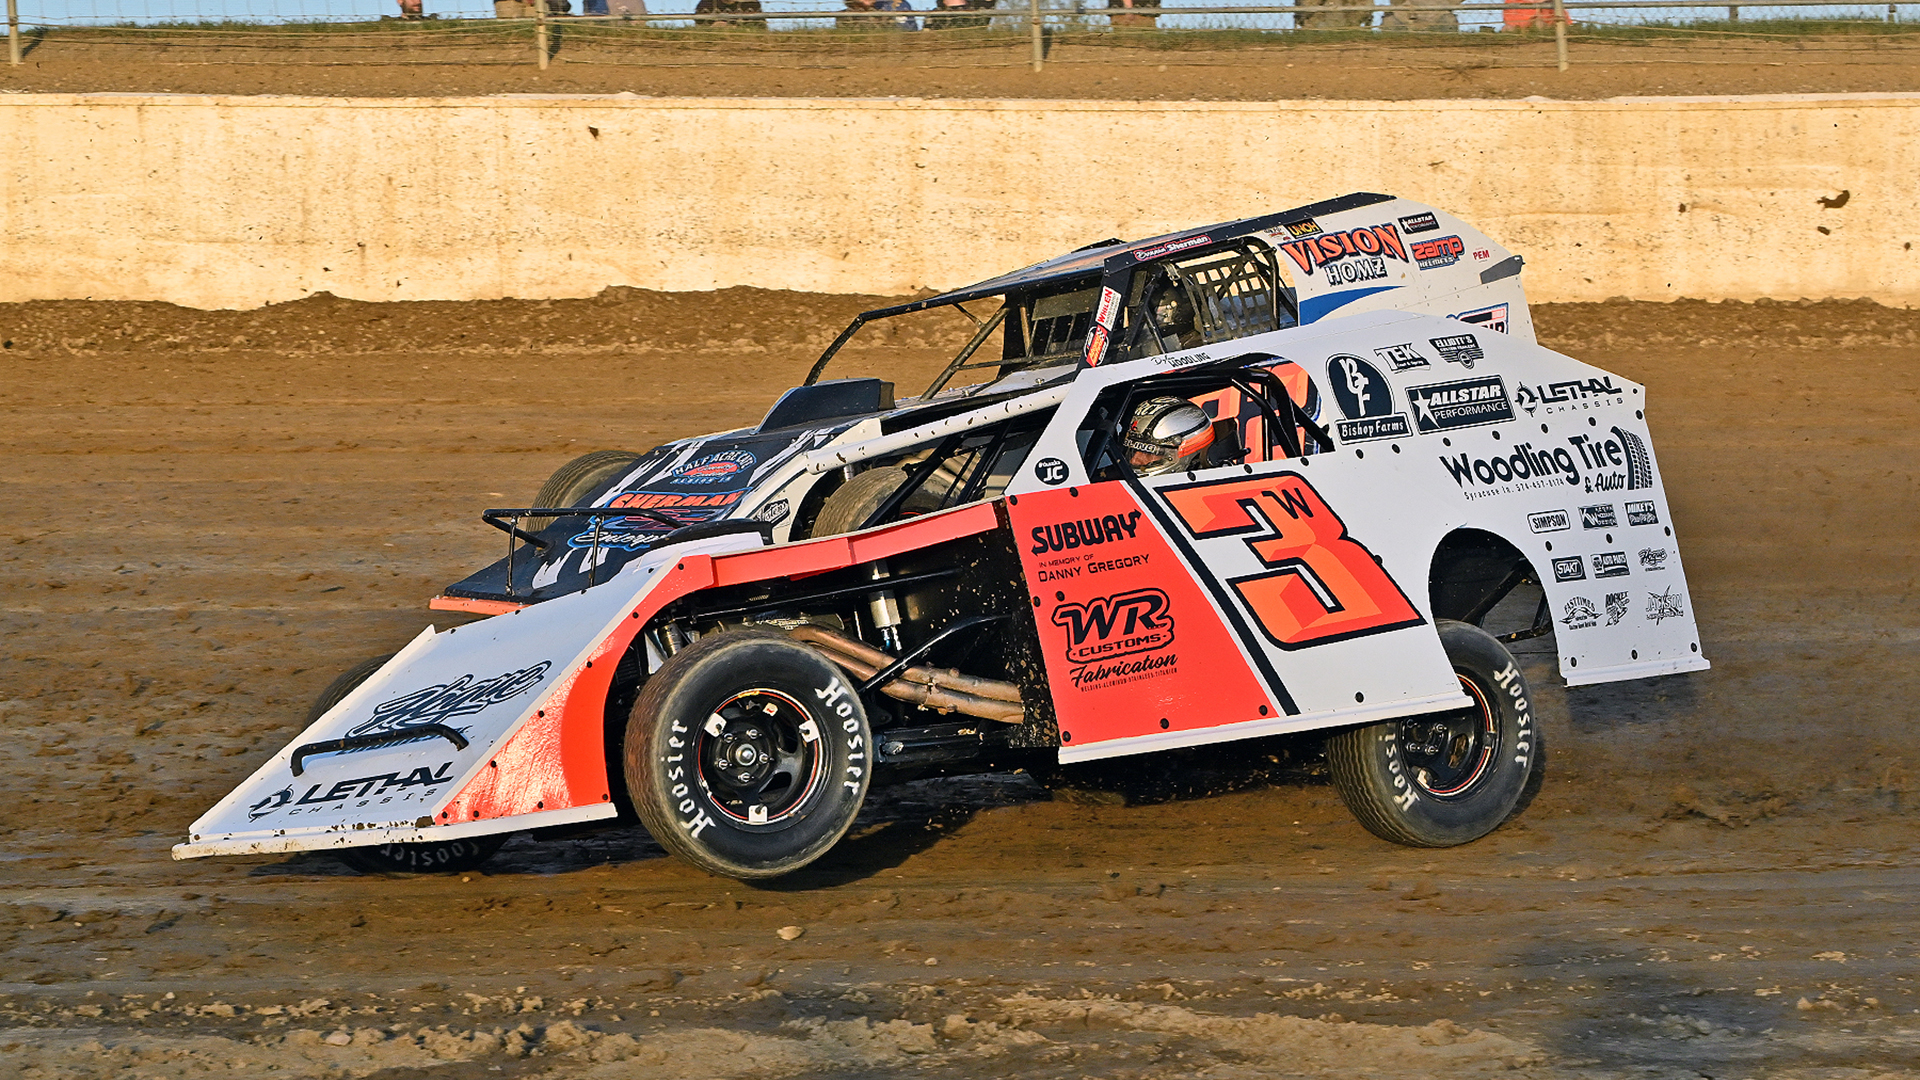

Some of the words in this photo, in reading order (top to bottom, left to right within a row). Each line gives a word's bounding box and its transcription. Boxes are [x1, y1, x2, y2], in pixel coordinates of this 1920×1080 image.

[1287, 221, 1320, 236] UNOH
[1407, 215, 1433, 227] ALLSTAR
[1166, 236, 1209, 252] Sherman
[1280, 223, 1409, 275] VISION
[1410, 235, 1464, 261] zamp
[1472, 249, 1491, 262] PEM
[1325, 257, 1388, 286] HOMZ
[1169, 352, 1211, 367] WOODLING
[1374, 343, 1421, 370] TEK
[1431, 384, 1502, 407] ALLSTAR
[1537, 376, 1622, 404] LETHAL
[1434, 401, 1509, 419] PERFORMANCE
[1546, 397, 1623, 415] CHASSIS
[1341, 425, 1373, 438] Bishop
[1374, 420, 1405, 434] Farms
[673, 456, 711, 476] HALF
[1439, 444, 1581, 488] Woodling
[1568, 430, 1623, 470] Tire
[1043, 465, 1063, 482] JC
[1584, 477, 1594, 494] &
[1594, 472, 1626, 491] Auto
[609, 490, 743, 508] SHERMAN
[1463, 489, 1500, 501] Syracuse
[1532, 513, 1567, 528] SIMPSON
[1031, 509, 1142, 556] SUBWAY
[1039, 560, 1047, 568] IN
[1048, 555, 1081, 566] MEMORY
[1084, 553, 1094, 562] OF
[1059, 595, 1164, 645] WR
[1079, 633, 1161, 657] CUSTOMS
[1069, 653, 1178, 688] Fabrication
[1493, 662, 1531, 768] Hoosier
[814, 676, 864, 796] Hoosier
[294, 762, 453, 805] LETHAL
[660, 719, 716, 839] Hoosier
[1379, 733, 1420, 811] Hoosi
[287, 789, 437, 816] CHASSIS
